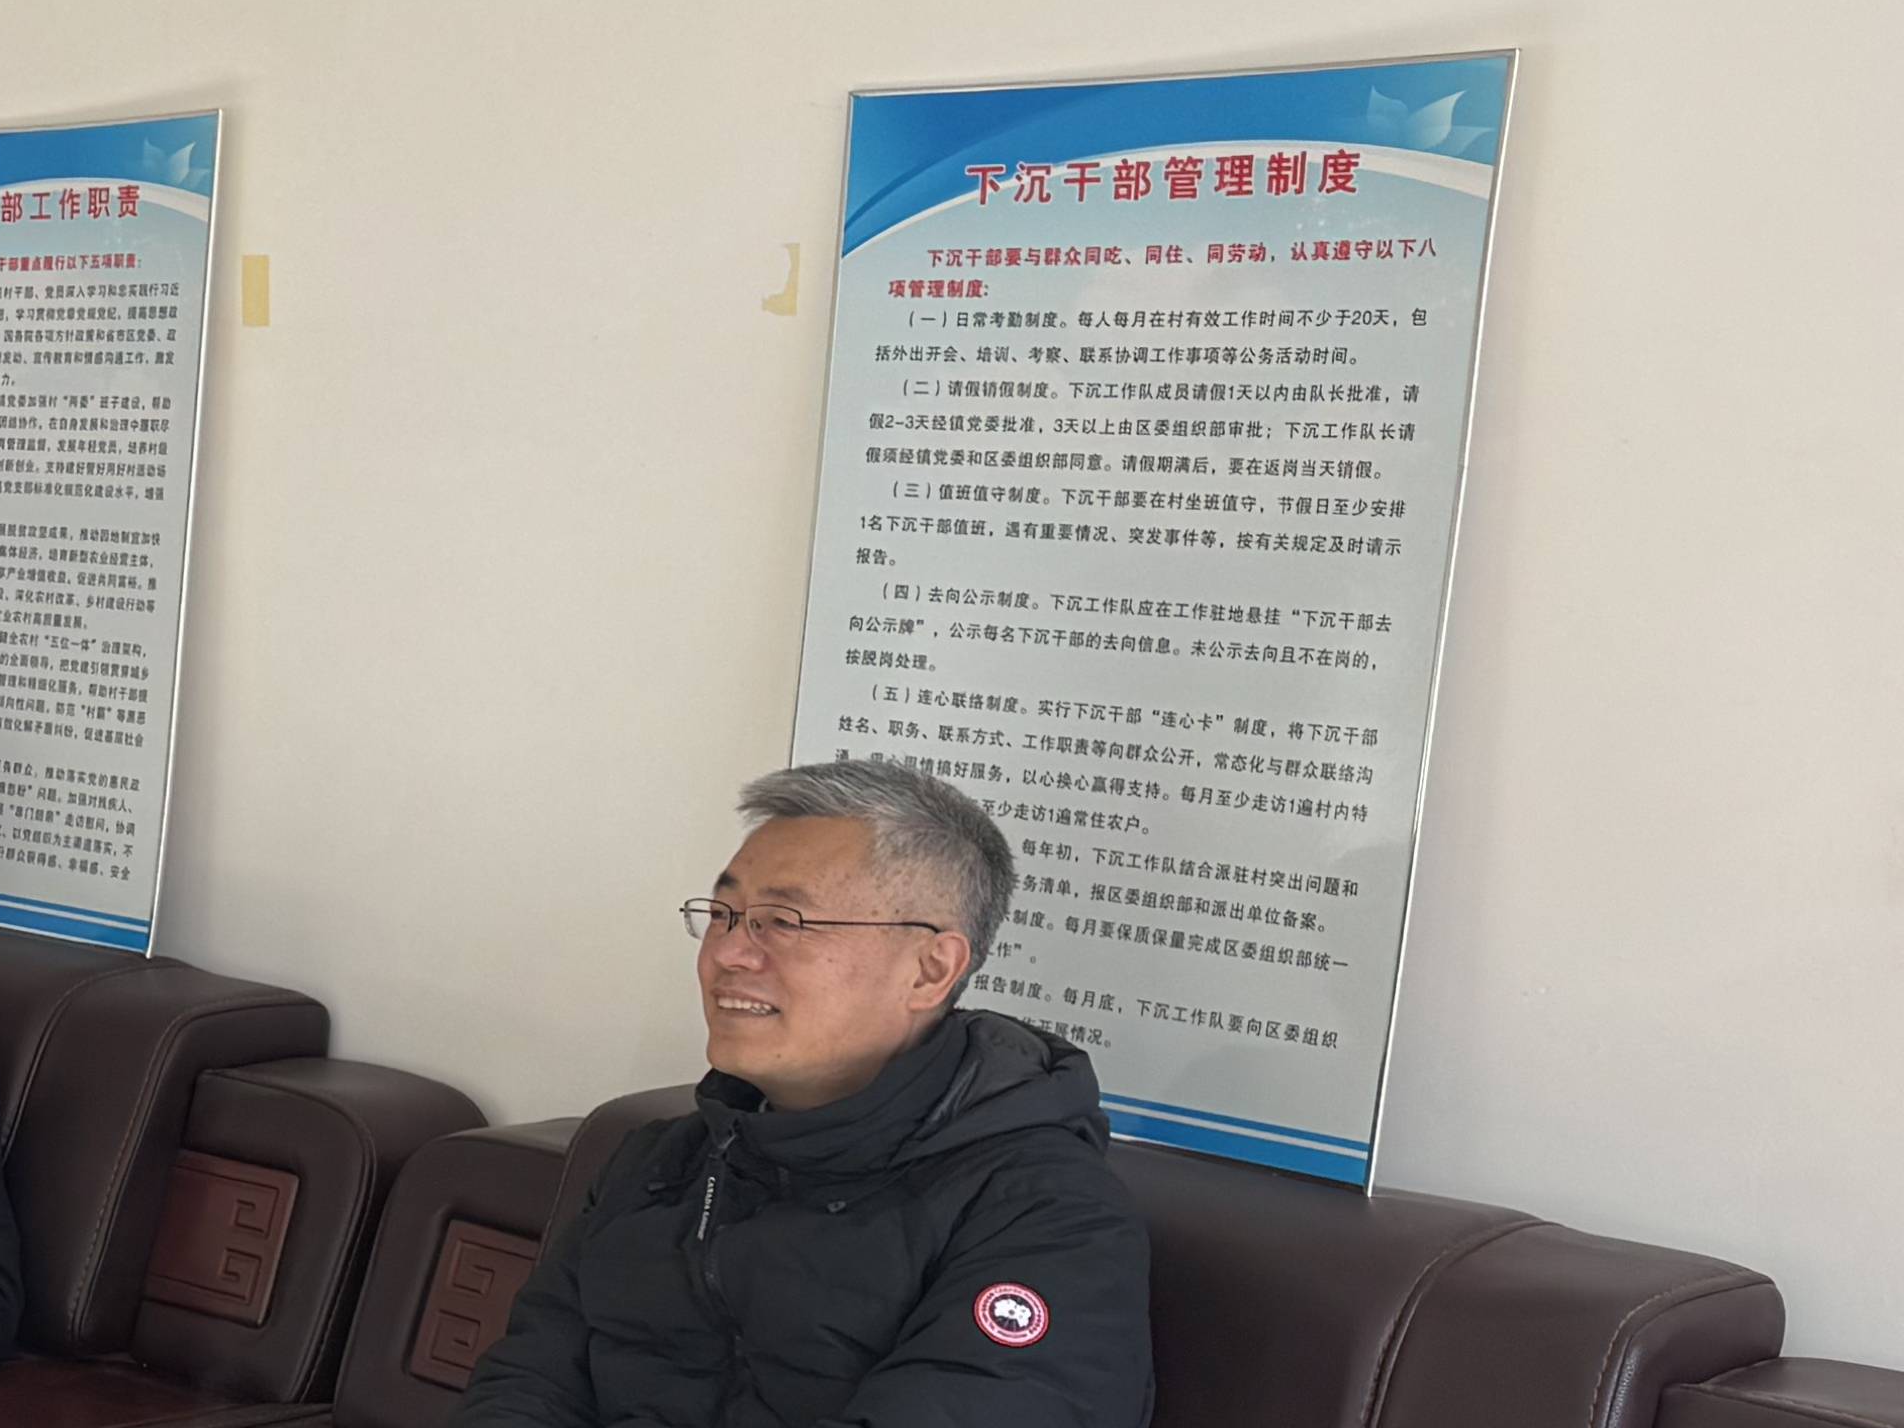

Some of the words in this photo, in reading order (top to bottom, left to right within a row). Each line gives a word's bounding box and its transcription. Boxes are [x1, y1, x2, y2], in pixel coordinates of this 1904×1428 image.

[962, 147, 1363, 207] 下沉干部管理制度
[925, 237, 1438, 268] 下沉干部要与群众同吃、同住、同劳动，认真遵守以下八
[906, 307, 1429, 328] （一）日常考勤制度。每人每月在村有效工作时间不少于20天，包
[875, 345, 1360, 365] 括外出开会、培训、考察、联系协调工作事项等公务活动时间。
[902, 379, 1419, 404] （二）请假销假制度。下沉工作队成员请假1天以内由队长批准，请
[864, 446, 1384, 481] 假须经镇党委和区委组织部同意。请假期满后，要在返岗当天销假。
[892, 481, 1406, 520] （三）值班值守制度。下沉干部要在村坐班值守，节假日至少安排
[860, 513, 1402, 557] 1名下沉干部值班，遇有重要情况、突发事件等，按有关规定及时请示
[855, 547, 898, 567] 报告。
[881, 582, 1393, 634] （四）去向公示制度。下沉工作队应在工作驻地悬挂“下沉干部去
[845, 647, 937, 672] 按脱岗处理。
[871, 683, 1379, 749] （五）连心联络制度。实行下沉干部“连心卡”制度，将下沉干部
[838, 713, 1373, 787] 姓名、职务、联系方式、工作职责等向群众公开，常态化与群众联络沟
[1021, 838, 1359, 900] 每年初，下沉工作队结合派驻村突出问题和
[999, 906, 1349, 975] 制度。每月要保质保量完成区委组织部统一
